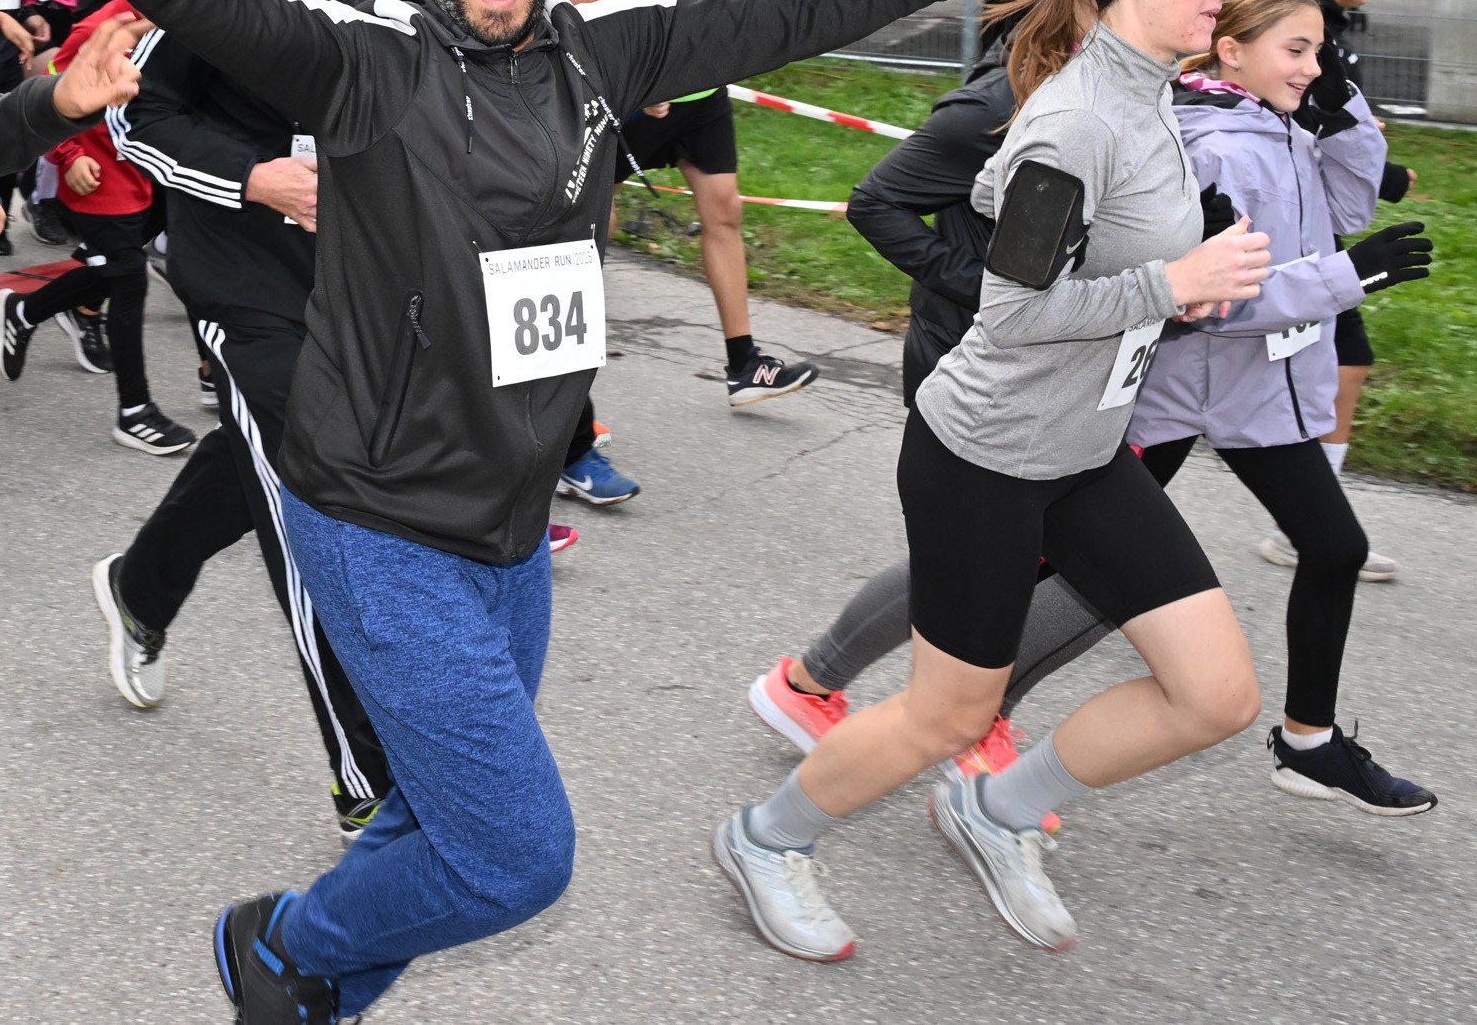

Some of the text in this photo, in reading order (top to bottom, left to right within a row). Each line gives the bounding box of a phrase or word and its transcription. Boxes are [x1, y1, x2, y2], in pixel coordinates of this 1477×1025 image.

[581, 134, 597, 166] NINETY
[488, 255, 551, 276] SALAMANDER
[554, 253, 572, 267] RUN
[513, 290, 588, 356] 834
